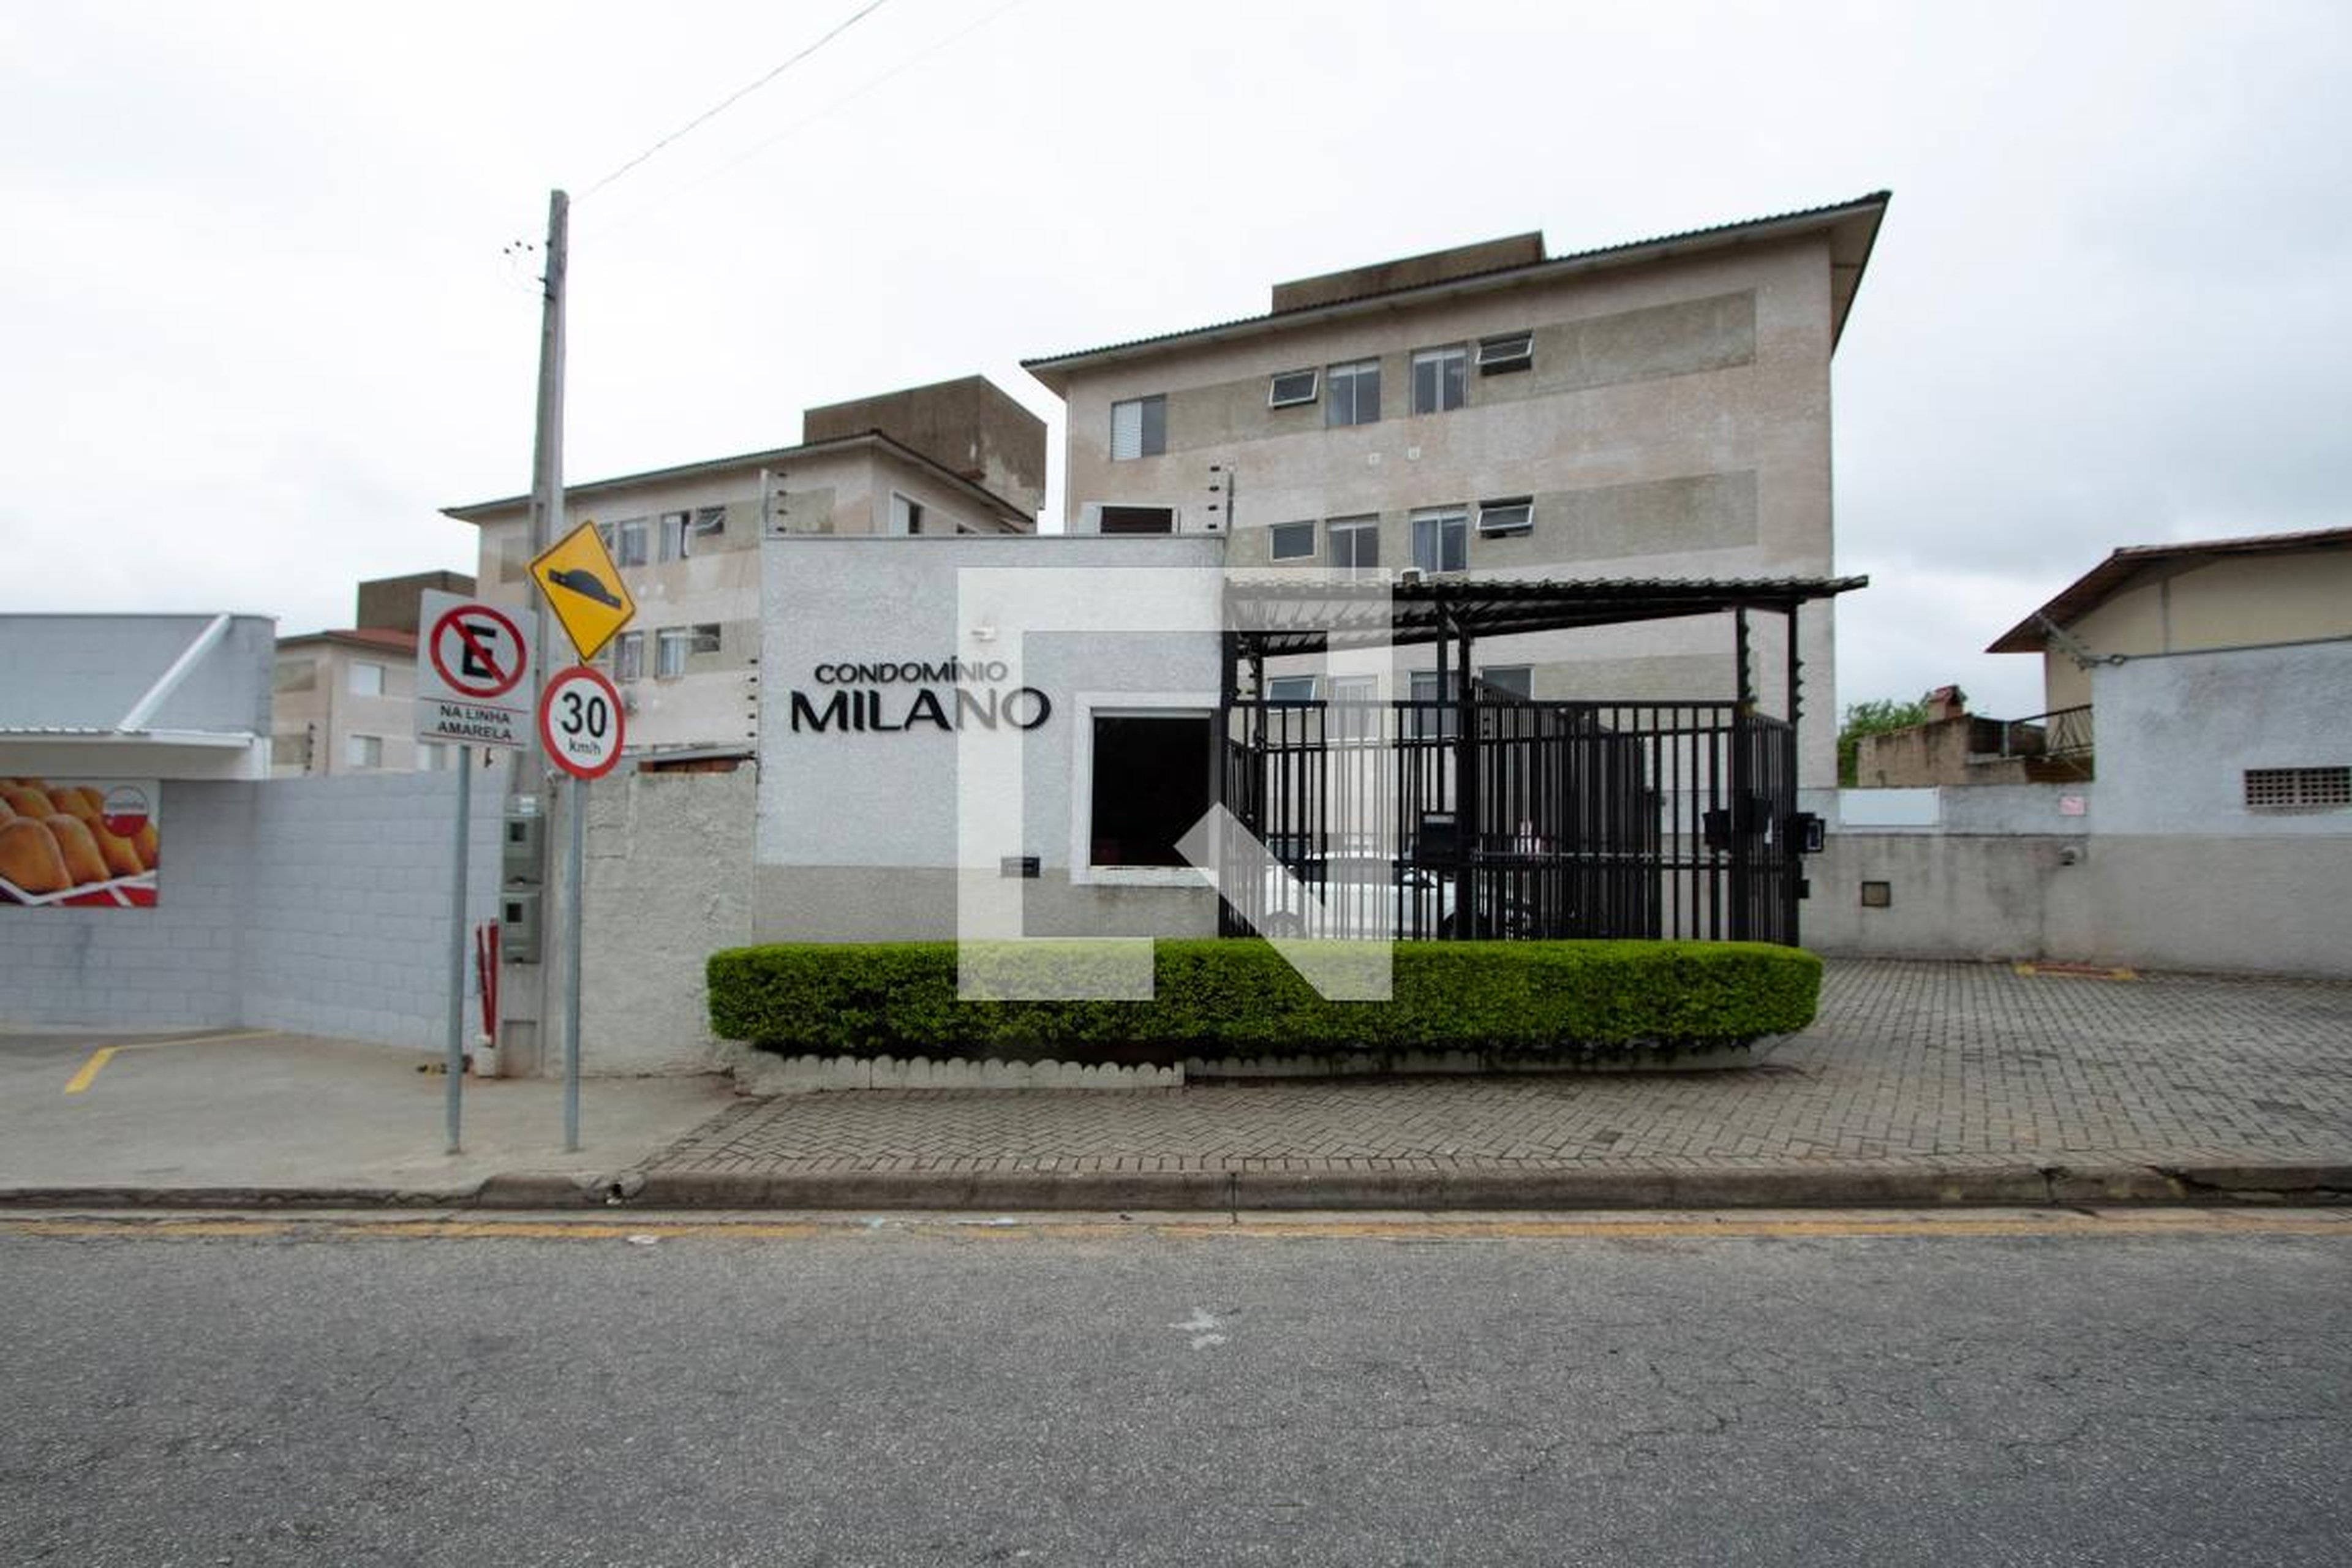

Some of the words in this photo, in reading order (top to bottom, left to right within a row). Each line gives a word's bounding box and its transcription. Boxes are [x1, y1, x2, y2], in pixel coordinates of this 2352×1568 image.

[462, 624, 496, 679] E
[815, 655, 1008, 684] CONDOMÍNIO
[440, 705, 461, 718] NA
[466, 707, 510, 723] LINHA
[561, 692, 606, 738] 30
[791, 687, 1052, 732] MILANO
[438, 722, 512, 740] AMARELA
